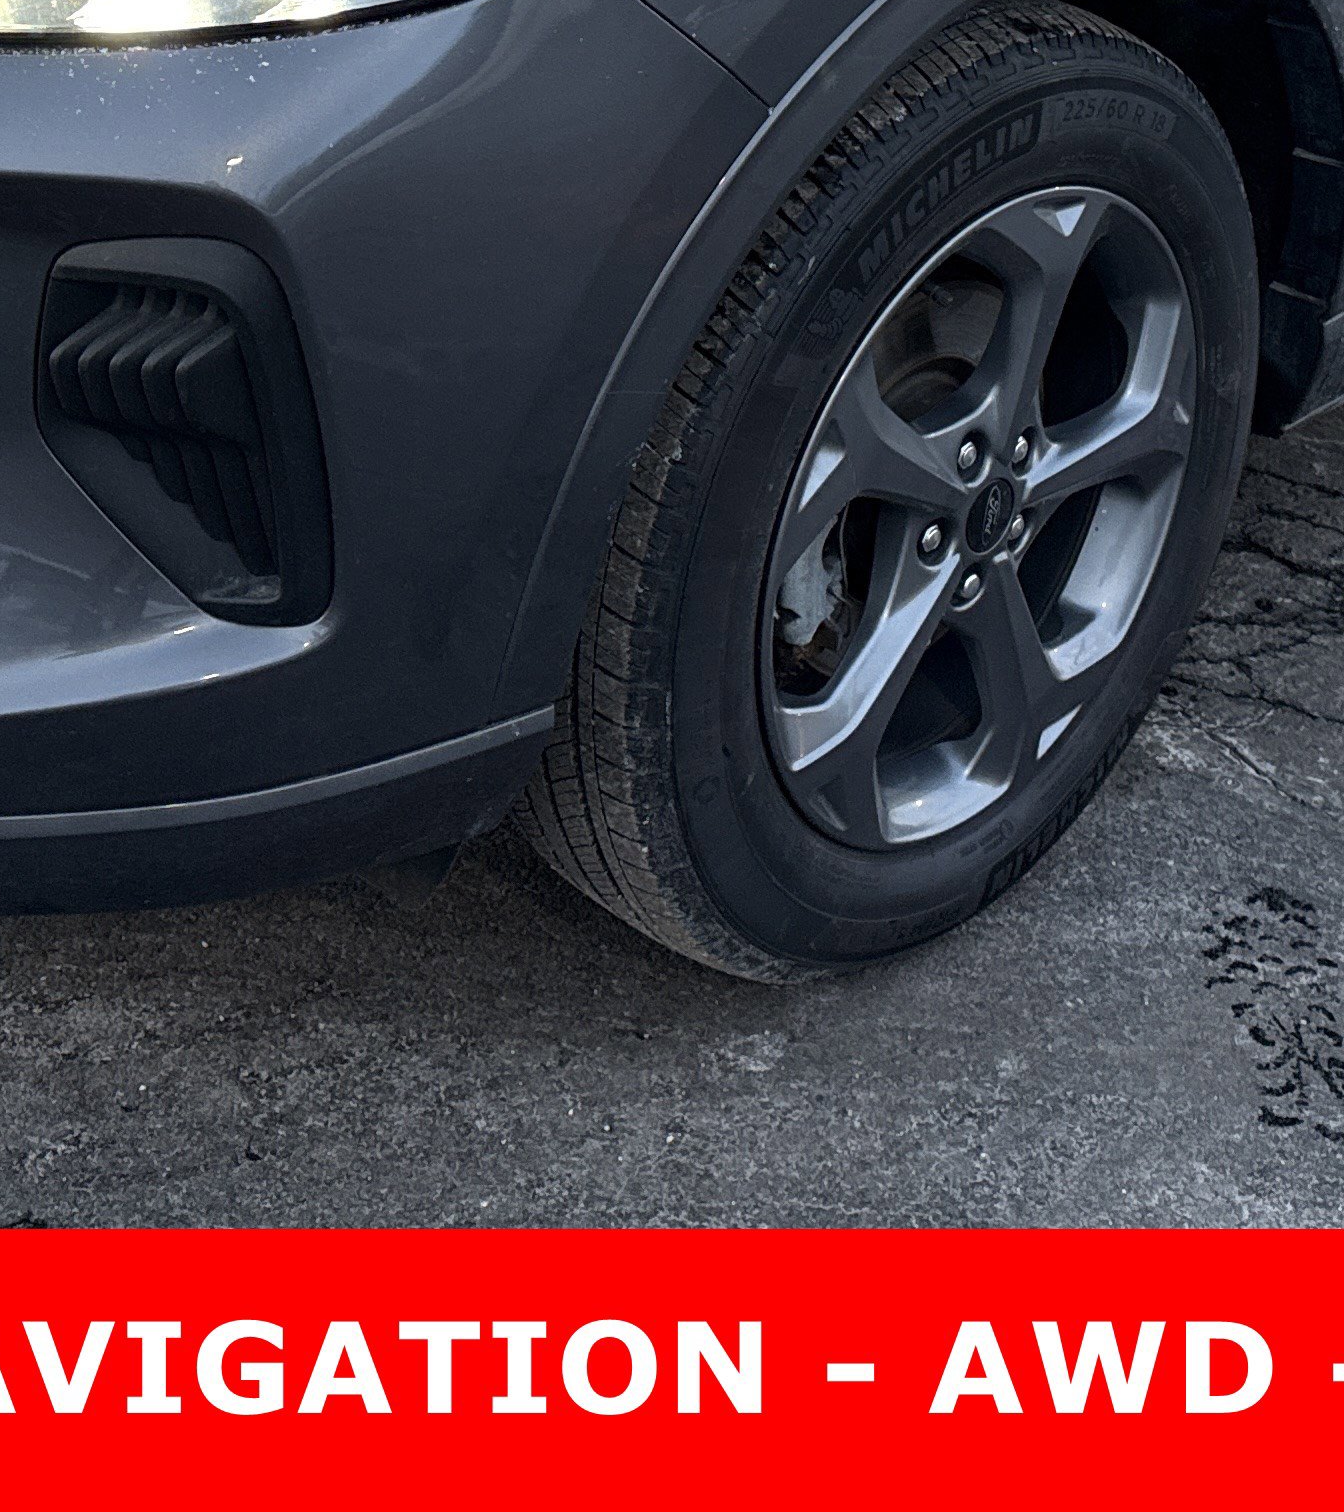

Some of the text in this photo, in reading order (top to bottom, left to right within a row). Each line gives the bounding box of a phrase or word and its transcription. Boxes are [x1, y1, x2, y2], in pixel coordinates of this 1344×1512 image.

[1061, 95, 1139, 122] 225/60
[1143, 104, 1156, 128] R
[858, 112, 1035, 281] MICHELIN
